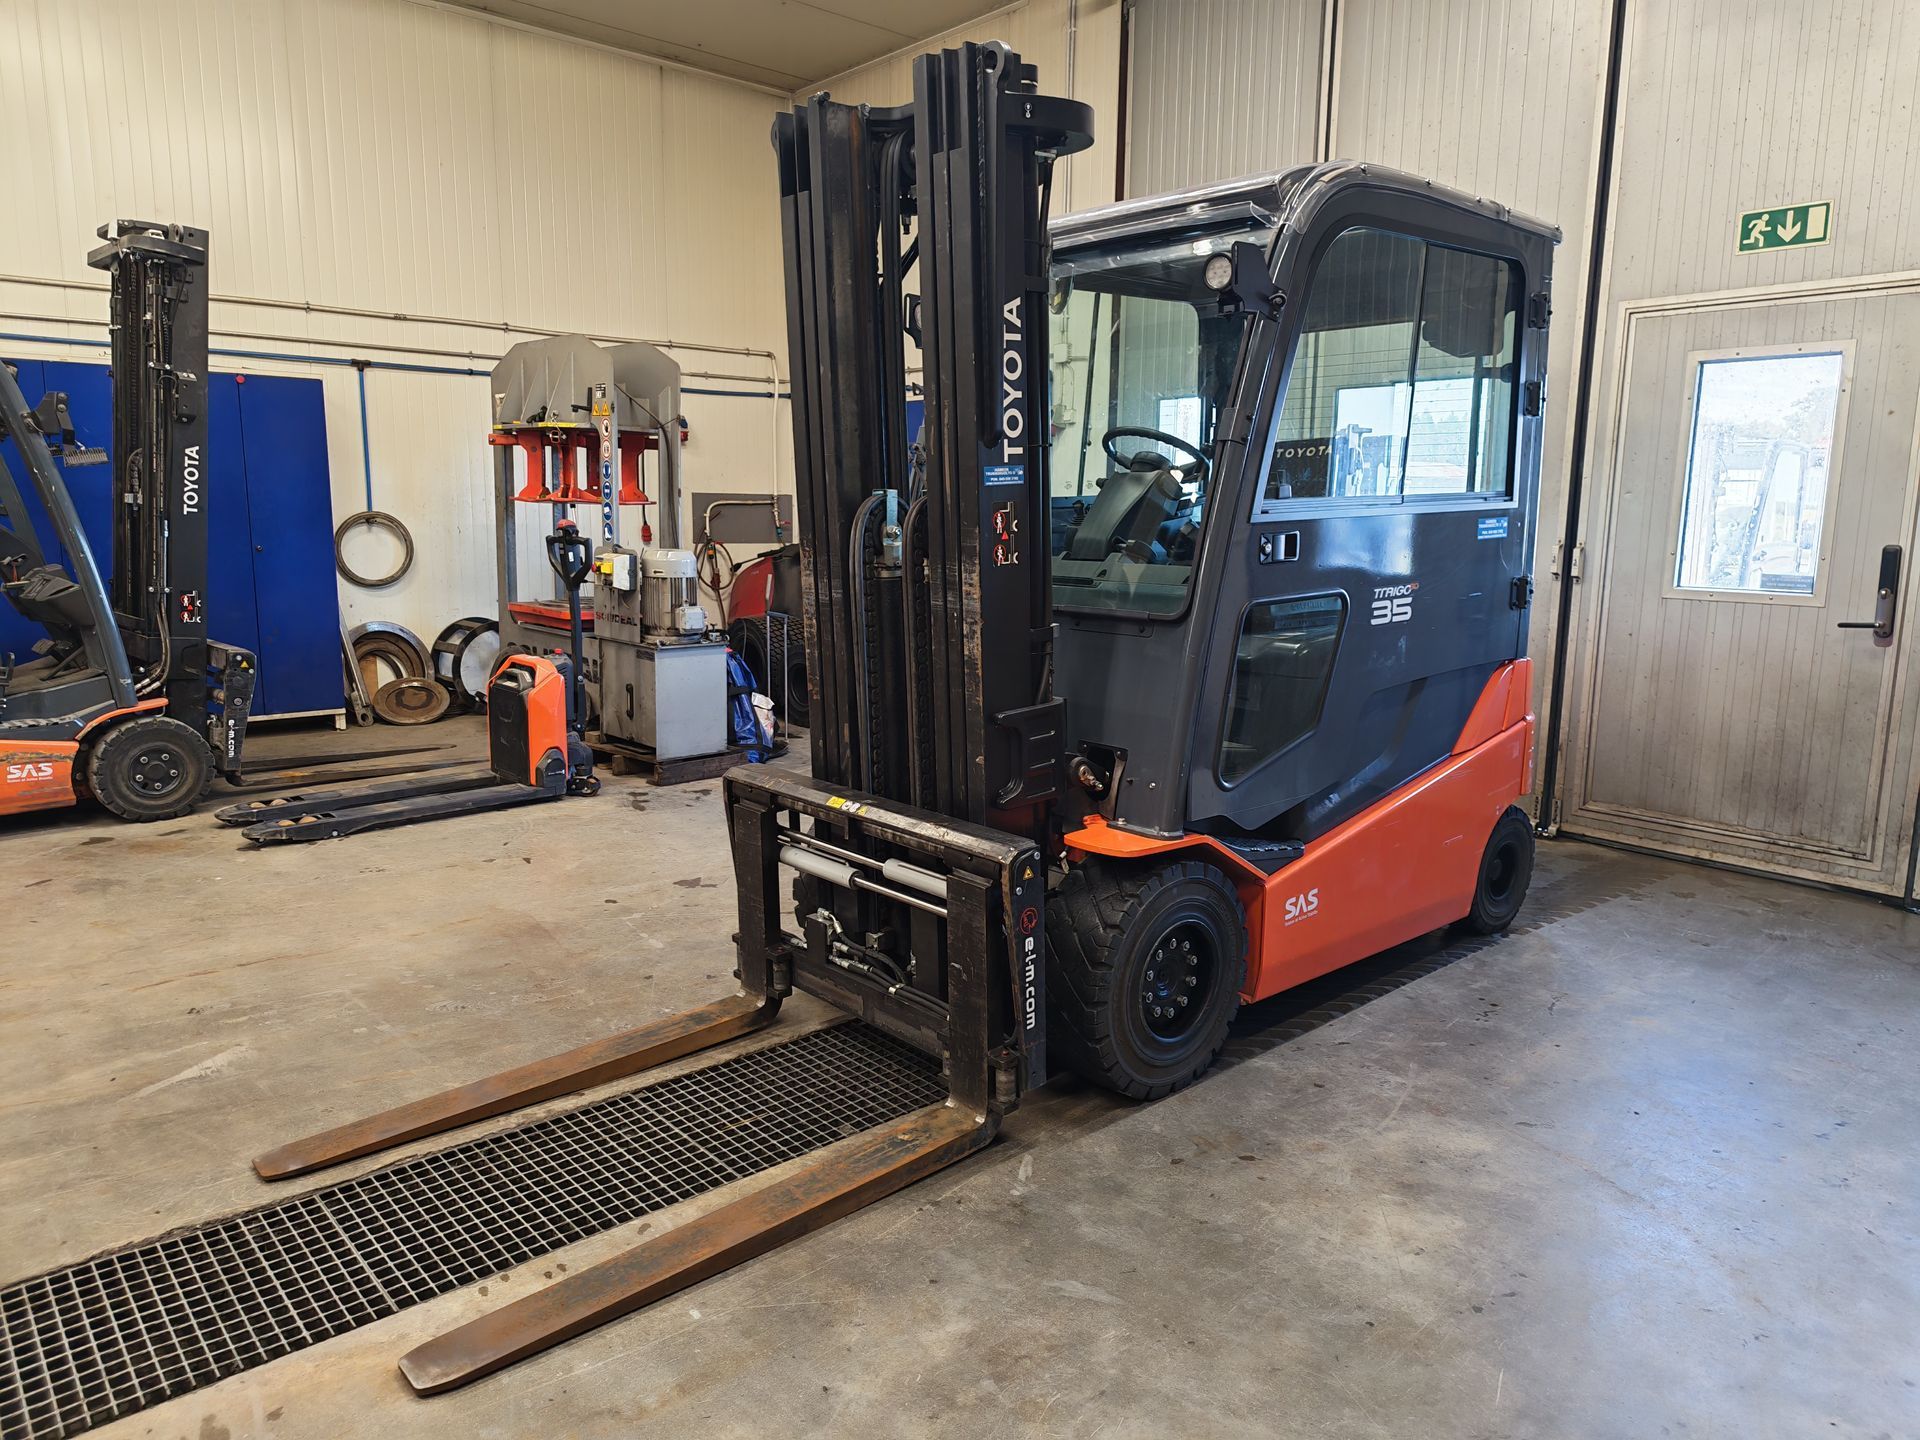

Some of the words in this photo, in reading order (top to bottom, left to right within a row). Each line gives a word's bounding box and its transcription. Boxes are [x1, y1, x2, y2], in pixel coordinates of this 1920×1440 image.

[1003, 297, 1024, 463] TOYOTA
[1276, 445, 1332, 458] TOYOTA
[183, 445, 200, 515] TOYOTA
[1370, 597, 1413, 626] 35
[6, 762, 54, 779] SAS
[1284, 888, 1319, 921] SAS
[1025, 936, 1037, 1030] e-l-m.com
